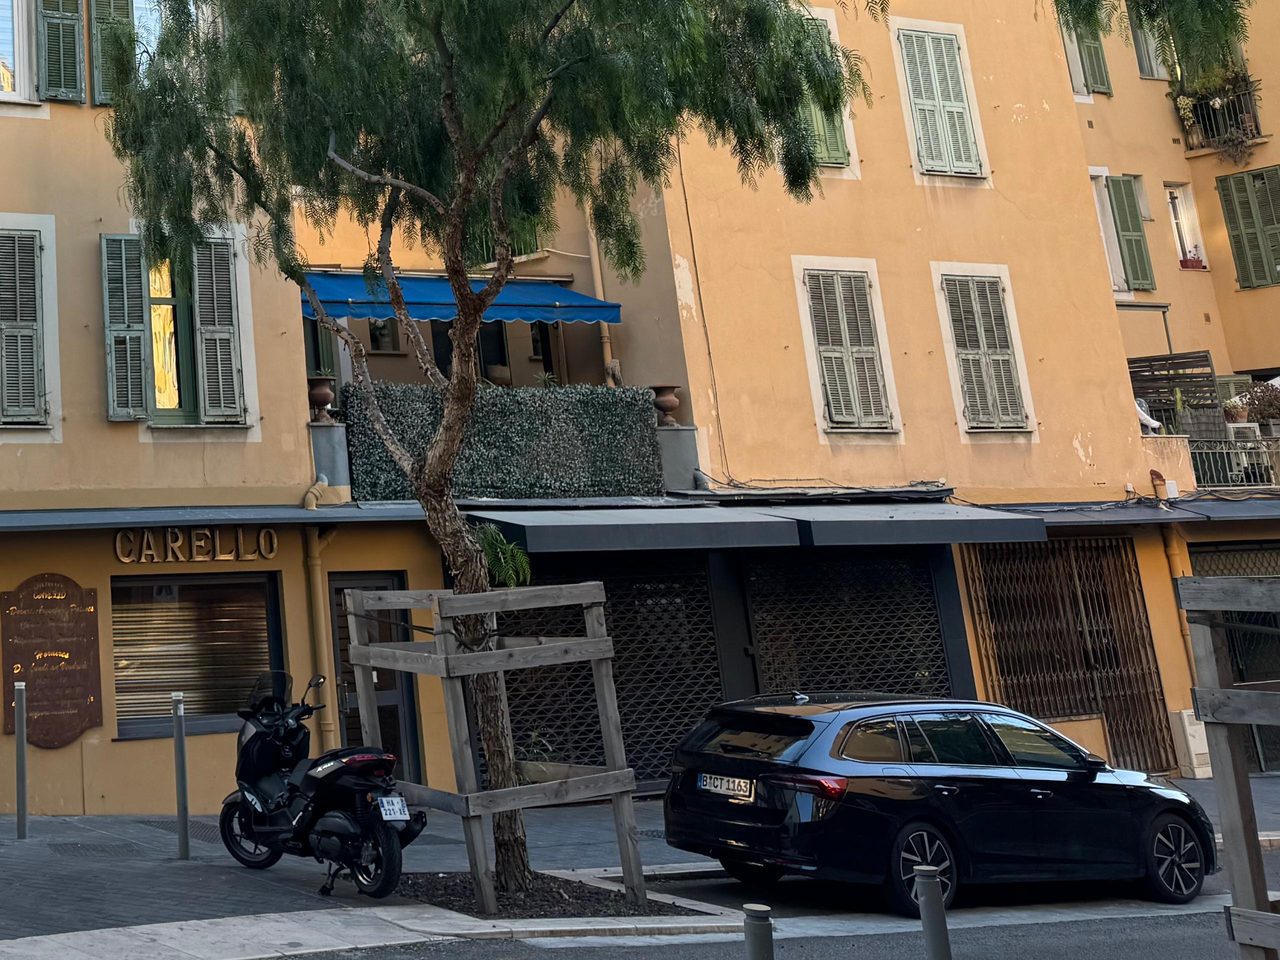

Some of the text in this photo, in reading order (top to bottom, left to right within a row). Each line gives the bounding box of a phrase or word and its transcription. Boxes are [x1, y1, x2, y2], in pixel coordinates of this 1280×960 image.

[115, 527, 279, 563] CARELLO
[713, 776, 724, 789] CT
[726, 779, 749, 793] 1163
